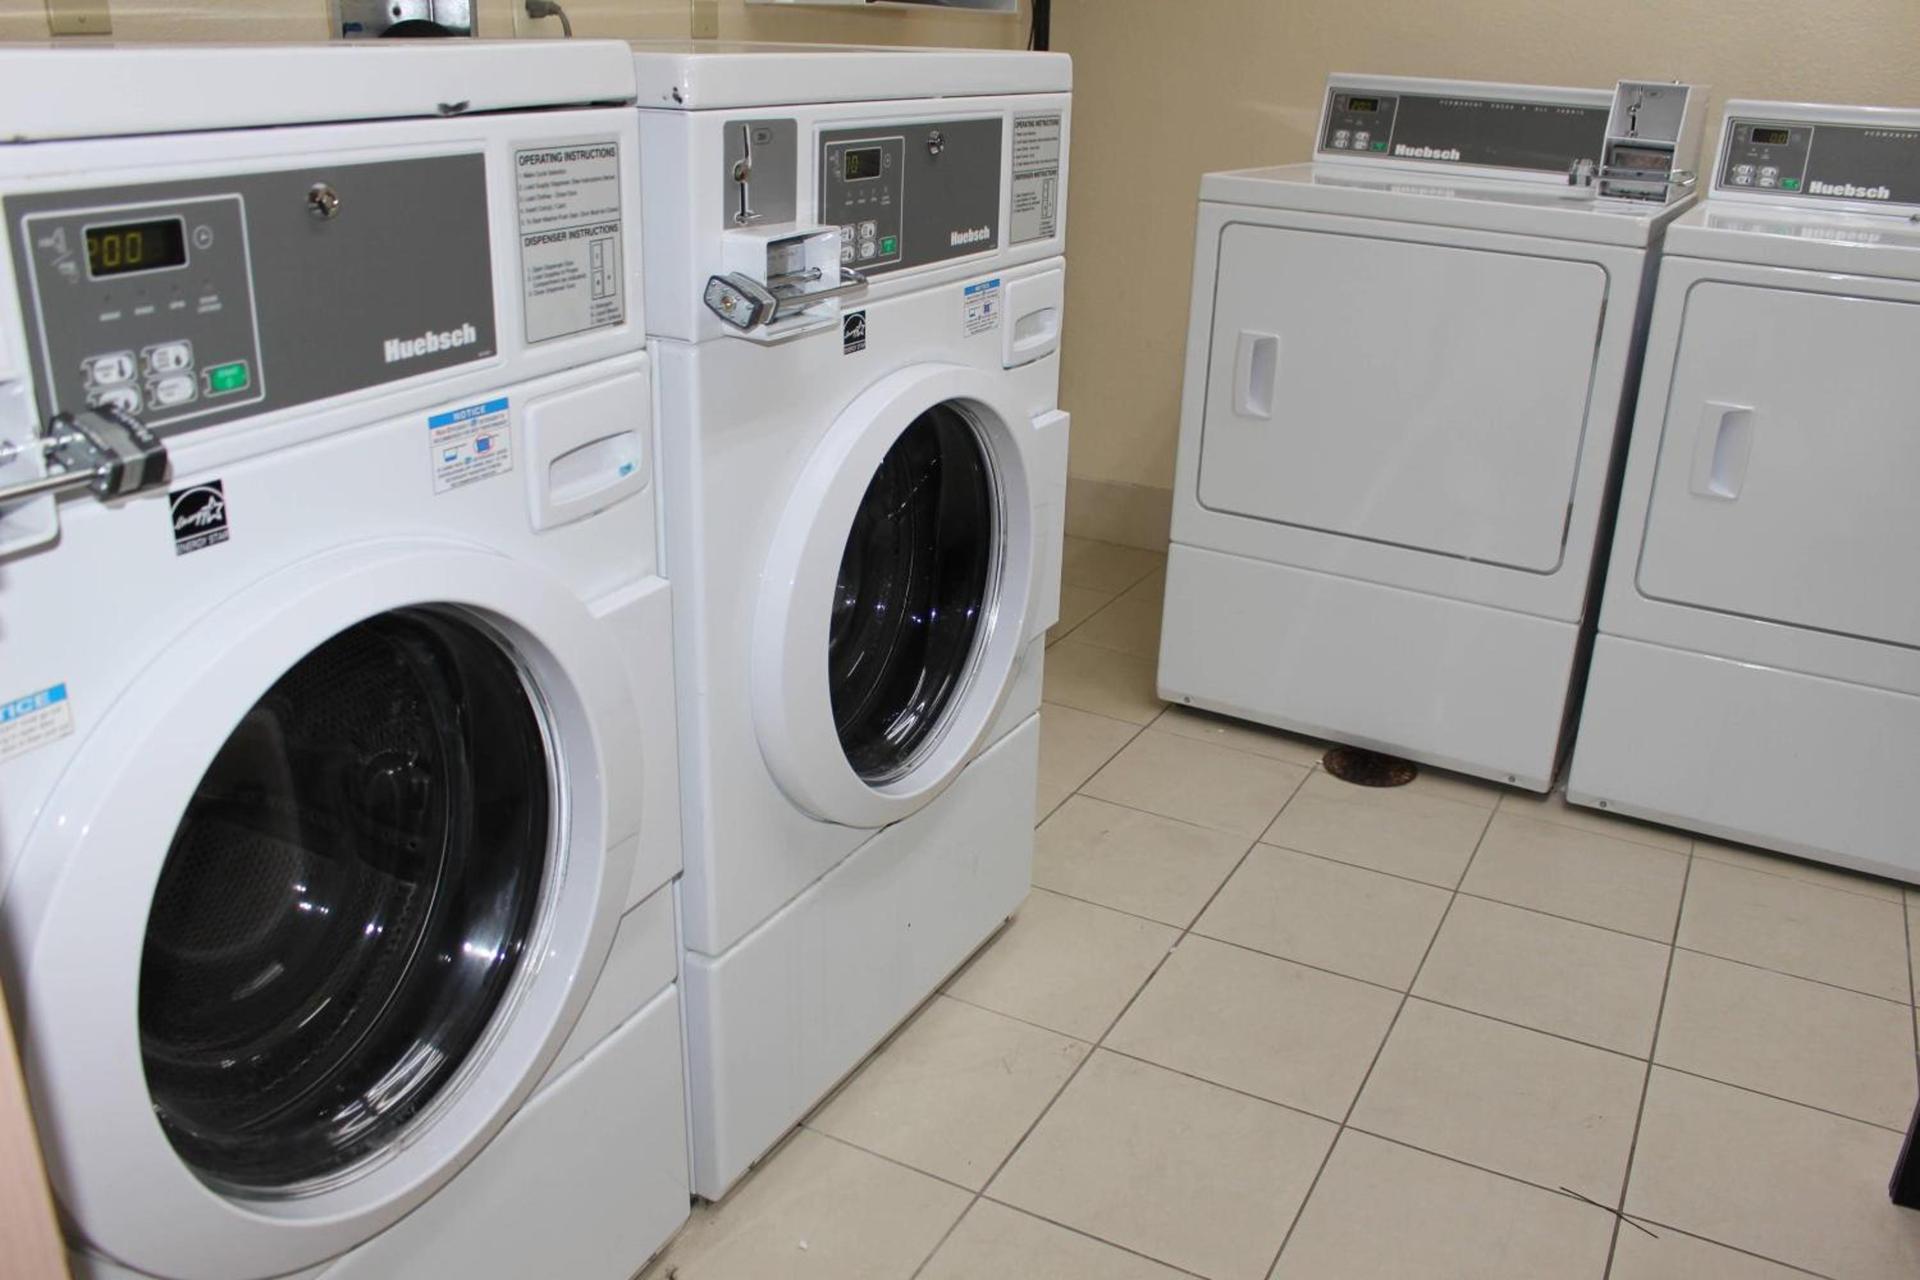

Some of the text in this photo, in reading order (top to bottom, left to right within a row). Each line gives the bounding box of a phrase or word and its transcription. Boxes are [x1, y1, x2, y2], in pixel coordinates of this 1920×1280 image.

[518, 146, 616, 167] OPERATING INSTRUCTIONS
[1394, 143, 1460, 161] Huebsch
[1808, 180, 1891, 200] Huebsch
[524, 223, 619, 248] DISPENSER INSTRUCTIONS
[950, 225, 991, 247] Huebsch
[384, 322, 478, 364] Huebsch
[453, 405, 487, 422] NOTICE
